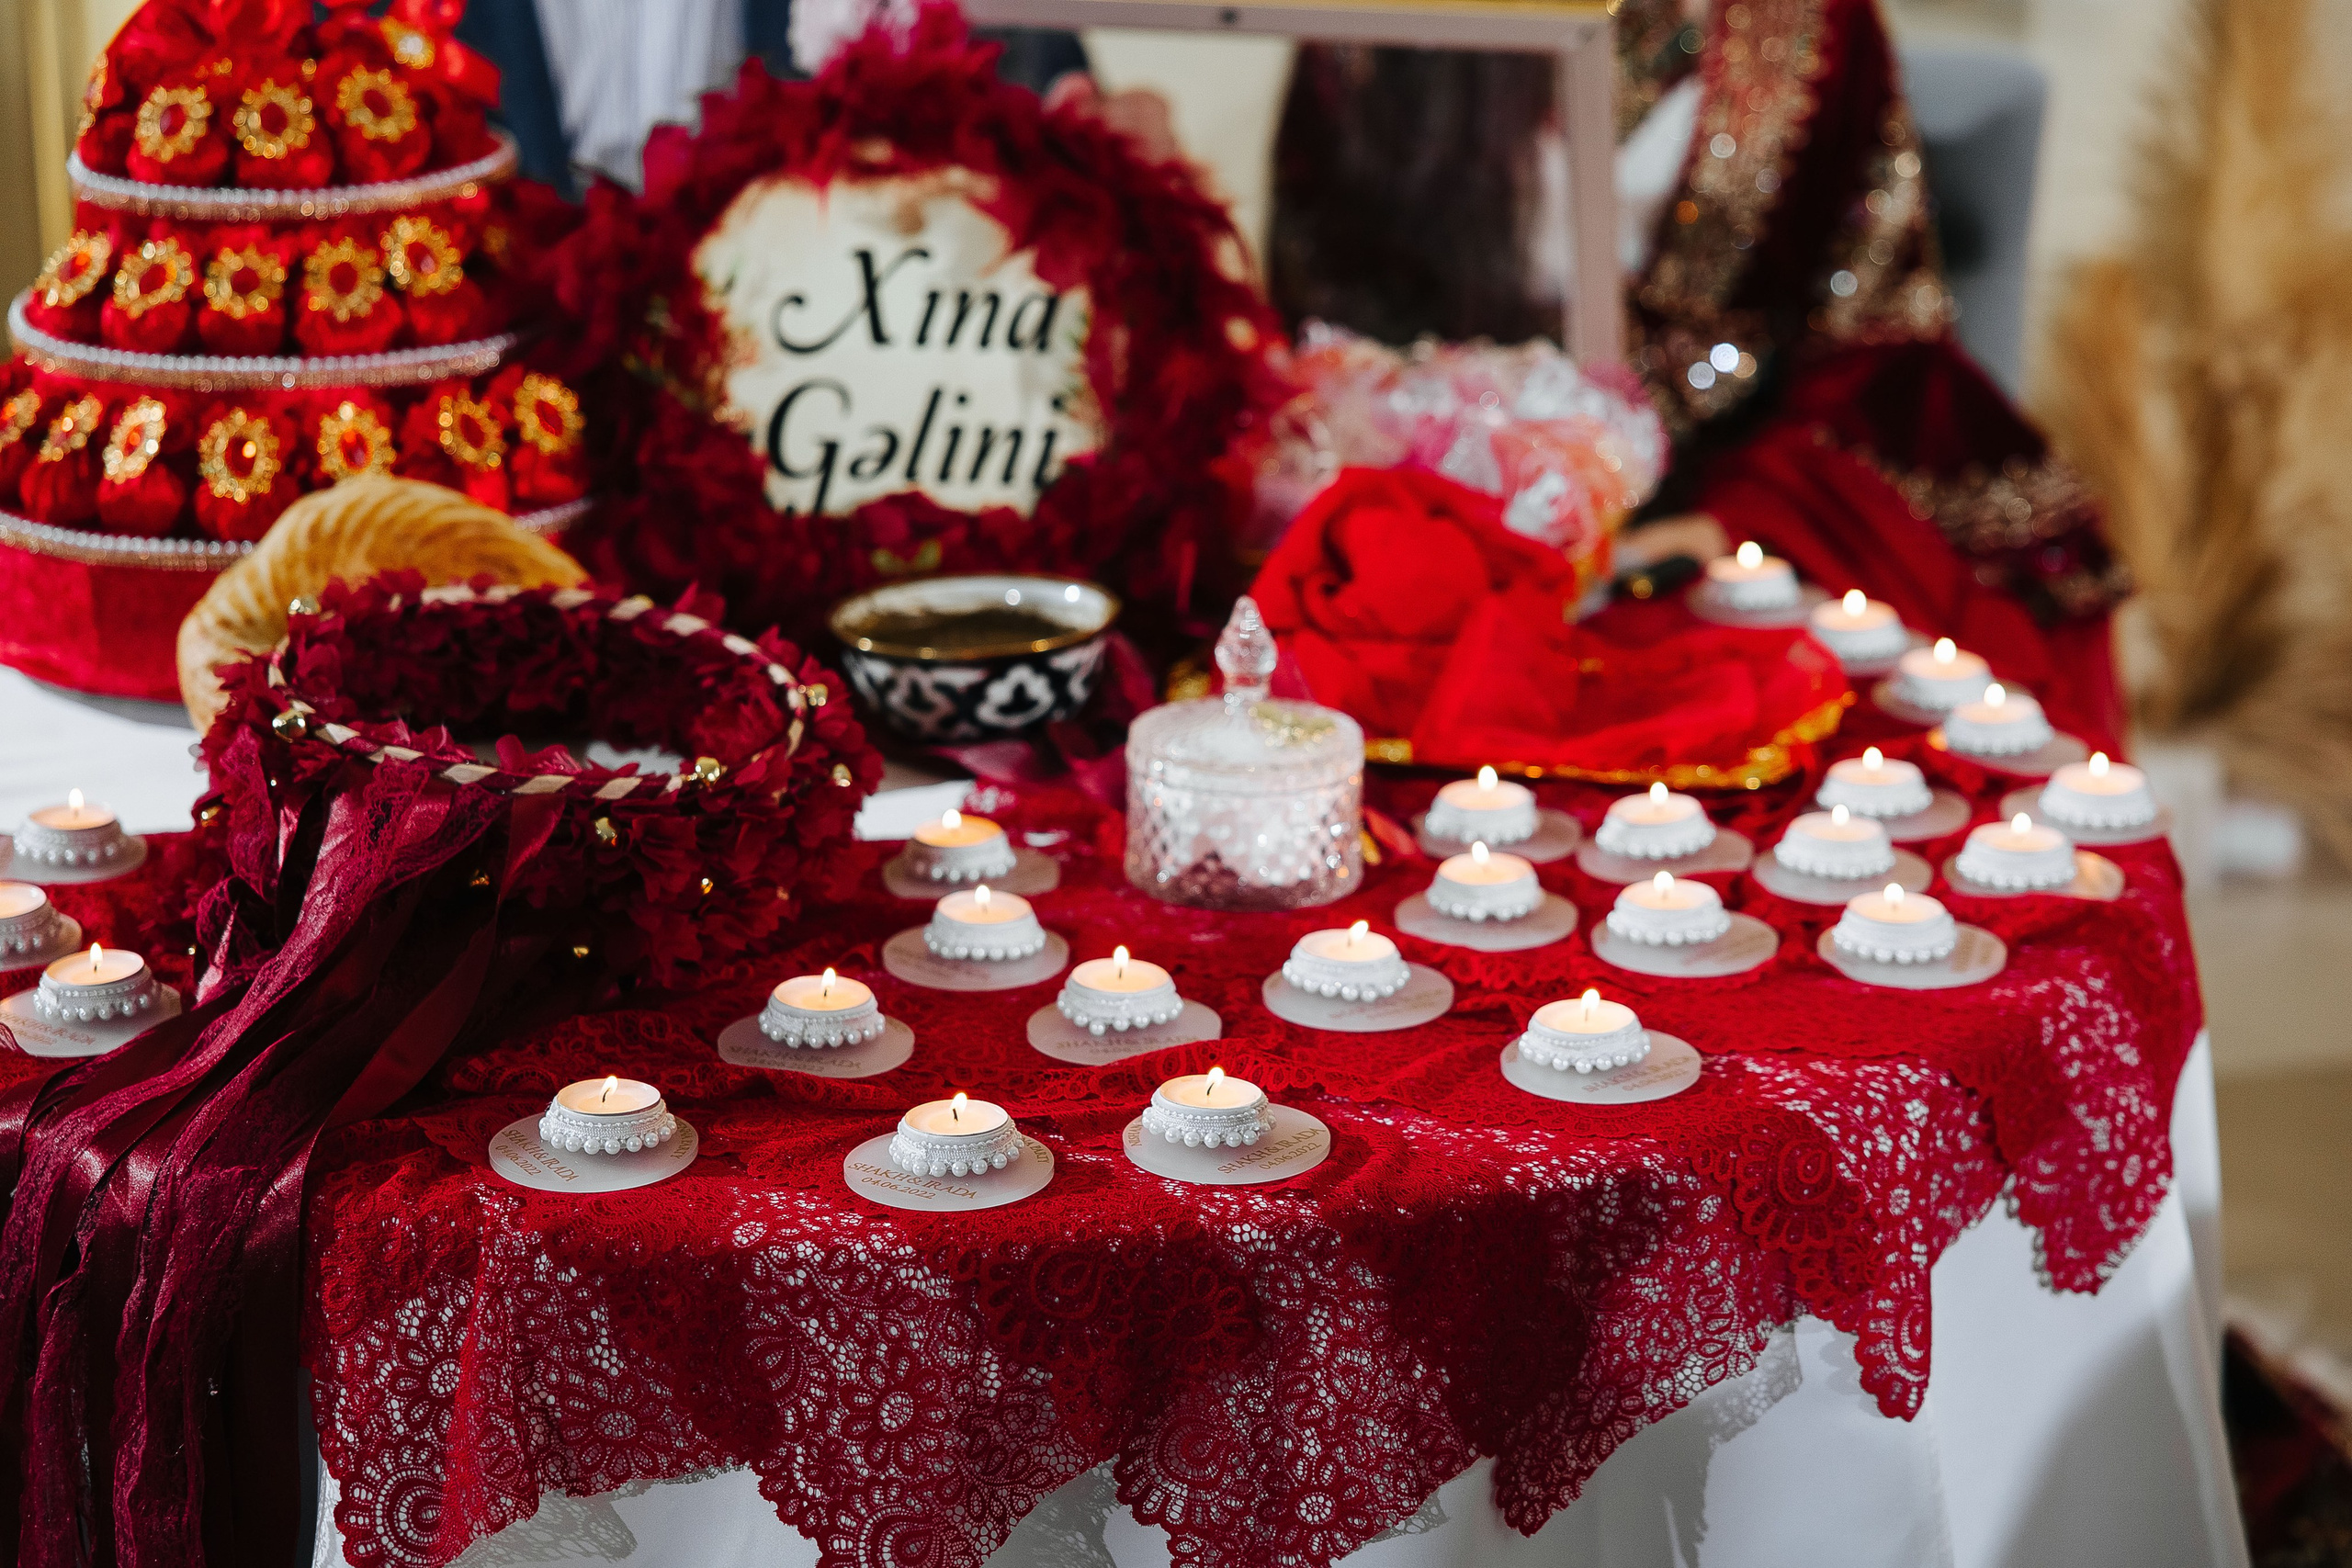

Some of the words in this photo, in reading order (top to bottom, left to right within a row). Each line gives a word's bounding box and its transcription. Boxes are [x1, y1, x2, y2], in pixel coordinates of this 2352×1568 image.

[1274, 1128, 1327, 1148] IRADA
[1029, 1145, 1050, 1164] PARTY
[541, 1157, 580, 1182] IRADA
[847, 1162, 905, 1182] SHAKH
[922, 1179, 978, 1200] IRADA
[861, 1177, 937, 1200] 04.06.2022
